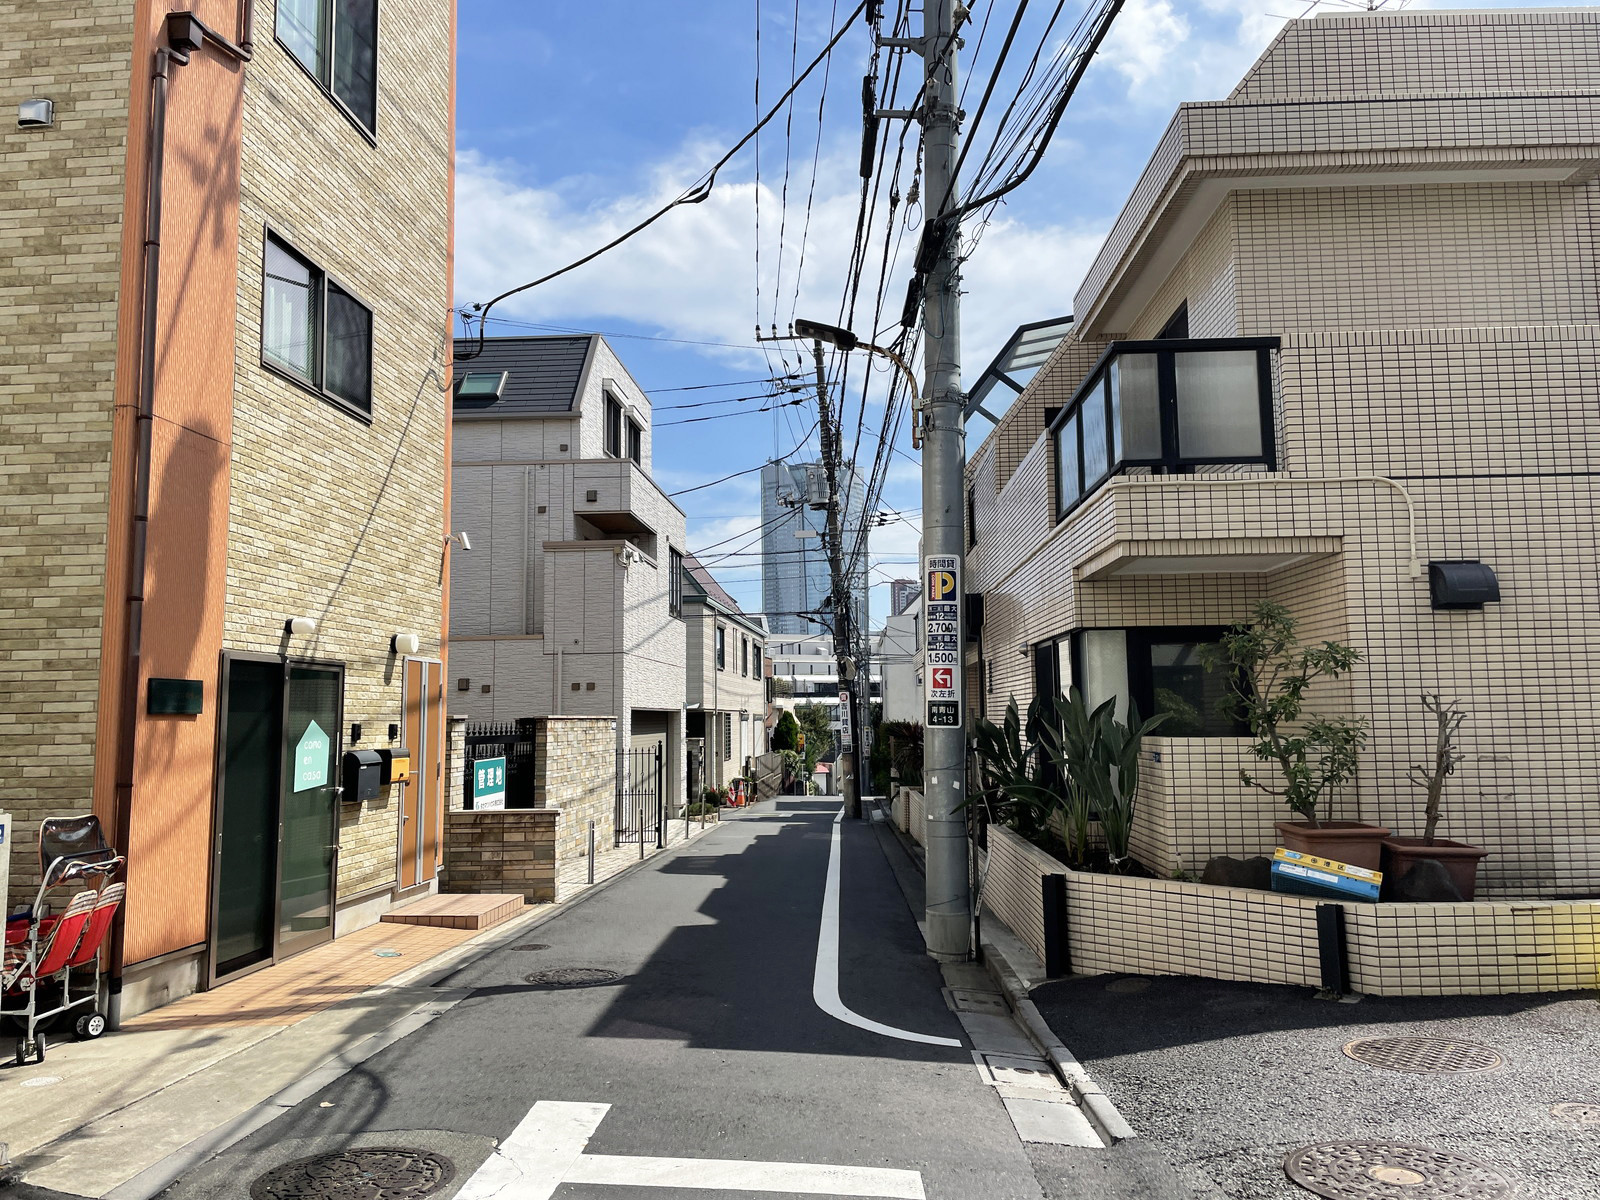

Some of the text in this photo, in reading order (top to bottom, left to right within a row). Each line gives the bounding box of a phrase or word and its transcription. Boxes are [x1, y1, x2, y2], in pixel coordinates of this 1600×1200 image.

[929, 560, 955, 569] 時間貸
[935, 572, 955, 600] P
[930, 690, 955, 698] 次左折
[931, 706, 955, 714] 南青山
[932, 715, 954, 723] 4-13
[304, 756, 313, 765] en
[302, 771, 321, 781] casa
[478, 766, 502, 789] 管理地
